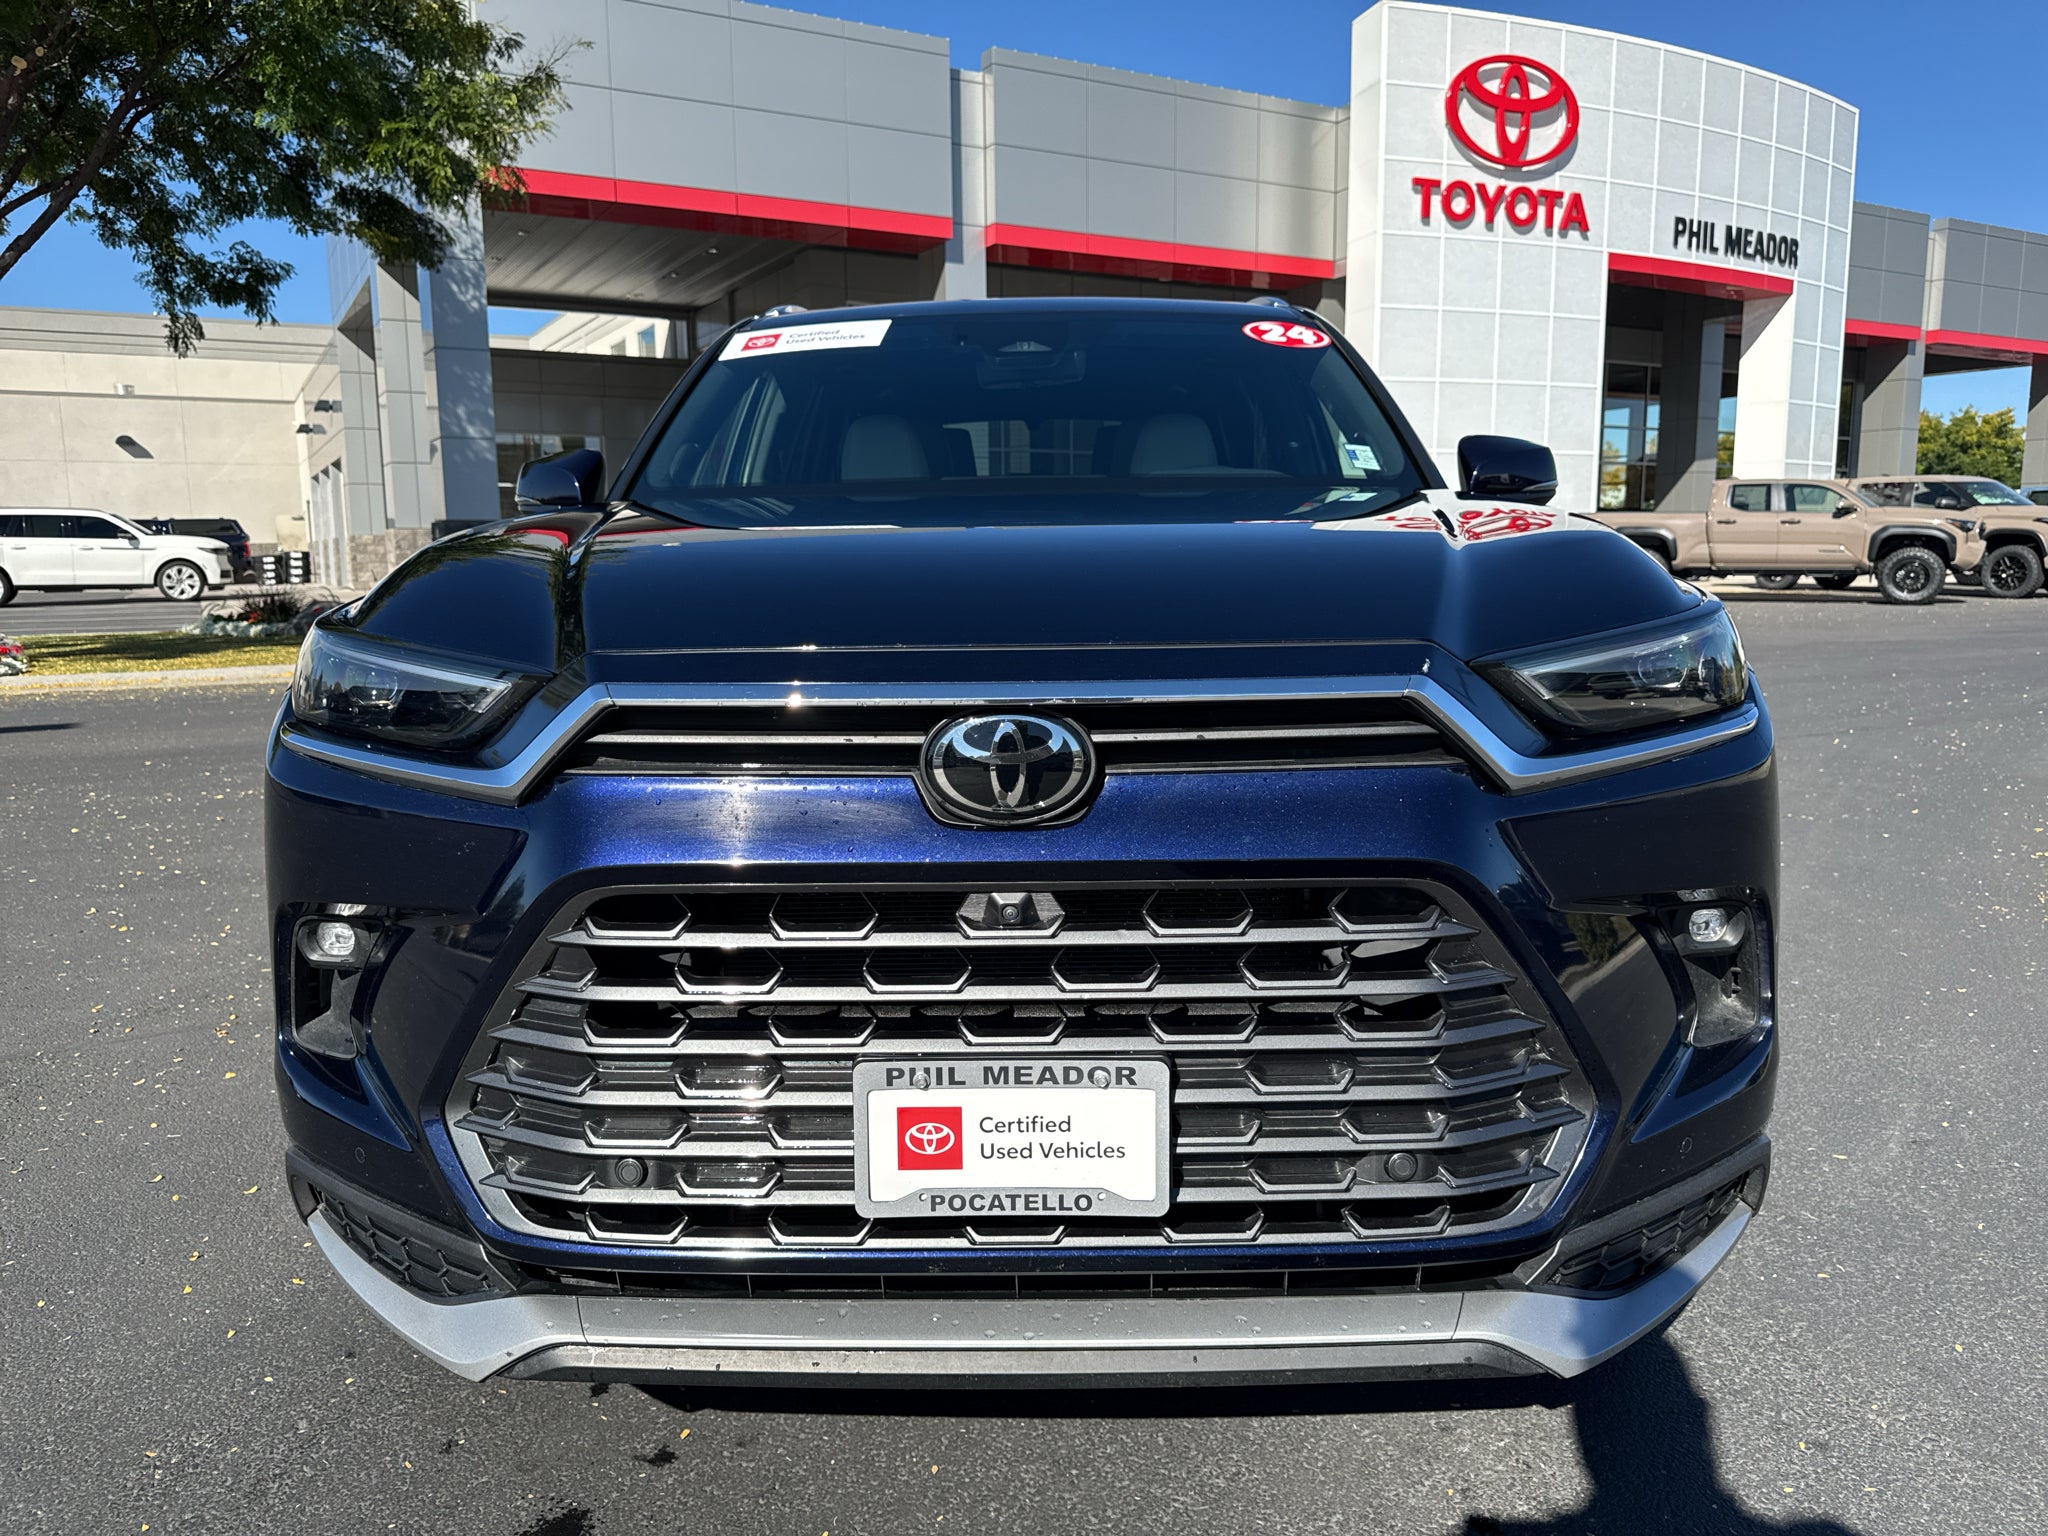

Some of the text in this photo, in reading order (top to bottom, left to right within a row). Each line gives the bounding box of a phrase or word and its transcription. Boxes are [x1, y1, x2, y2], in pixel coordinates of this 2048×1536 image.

[1412, 177, 1590, 232] TOYOTA
[1673, 216, 1799, 269] PHIL MEADOR
[786, 333, 866, 345] Used Vehicles
[789, 329, 840, 339] Certified
[1258, 324, 1318, 345] 24
[983, 1066, 1137, 1086] MEADOR
[979, 1115, 1072, 1134] Certified
[980, 1141, 1126, 1159] Used Vehicles
[930, 1193, 1093, 1212] POCATELLO
